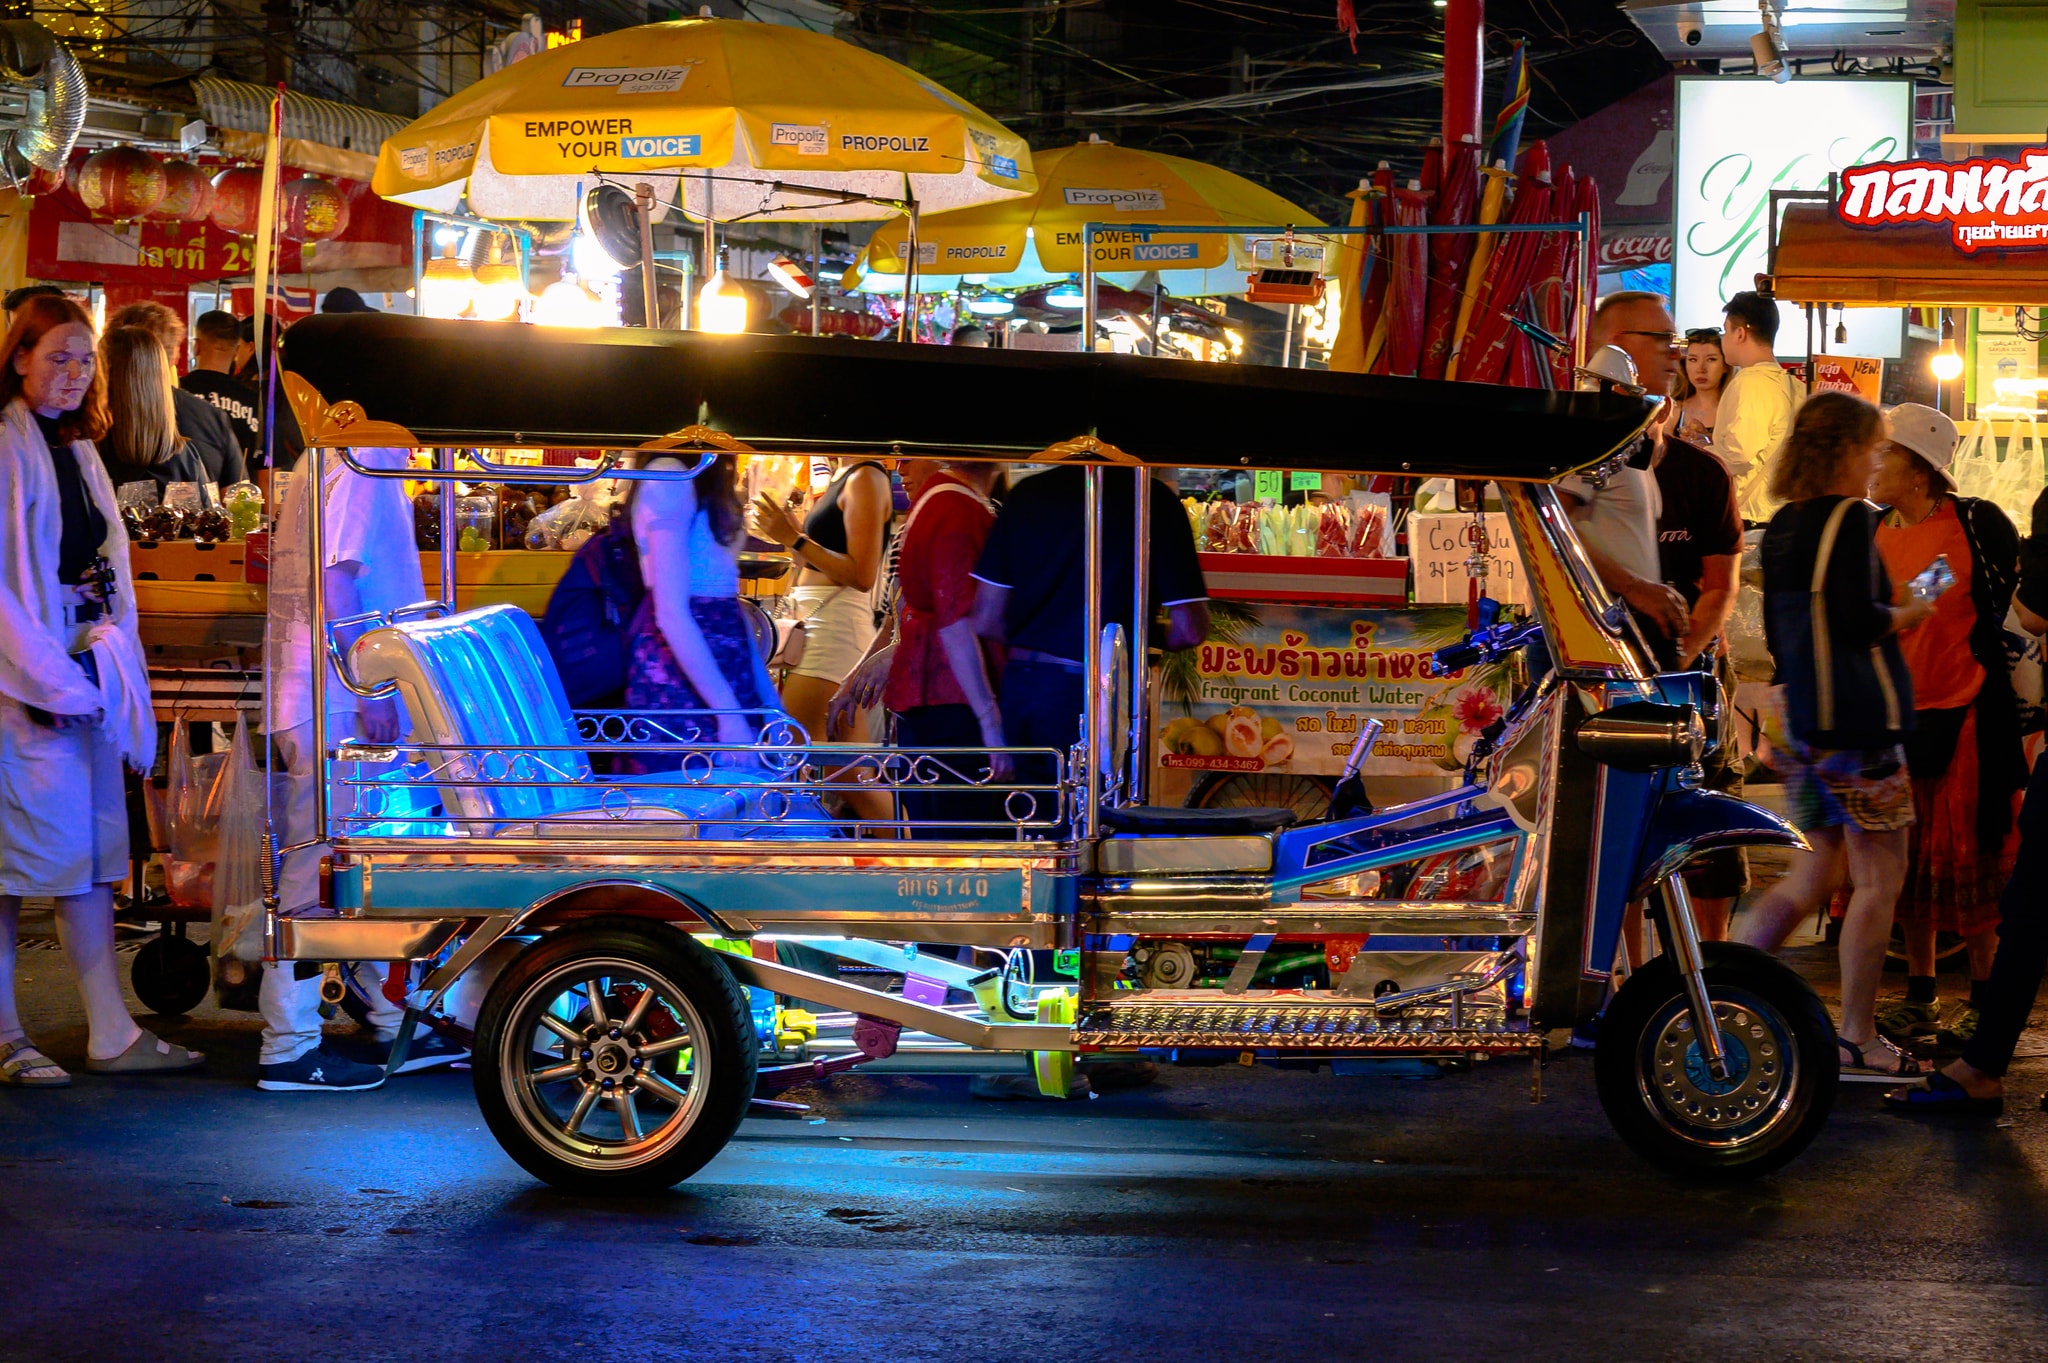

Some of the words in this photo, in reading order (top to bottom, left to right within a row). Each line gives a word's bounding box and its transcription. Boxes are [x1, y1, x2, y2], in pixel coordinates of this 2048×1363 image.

[575, 69, 684, 85] Propoliz
[630, 82, 675, 93] spray
[525, 118, 633, 138] EMPOWER
[776, 128, 826, 143] Propoliz
[558, 141, 618, 158] YOUR
[625, 137, 693, 157] VOICE
[841, 134, 930, 153] PROPOLIZ
[1072, 190, 1160, 204] Propoliz
[139, 225, 206, 270] เลขที่
[1056, 231, 1142, 245] EMOWER
[946, 246, 1007, 259] PROPOLIZ
[1094, 248, 1131, 260] OUR
[1137, 245, 1190, 259] VOICE
[208, 392, 259, 432] Angels
[1259, 471, 1279, 492] 50
[1288, 685, 1360, 703] Coconut
[1369, 687, 1424, 705] Water
[1296, 717, 1322, 732] สด
[1326, 711, 1356, 733] ใหม่
[1404, 719, 1446, 735] หวาน
